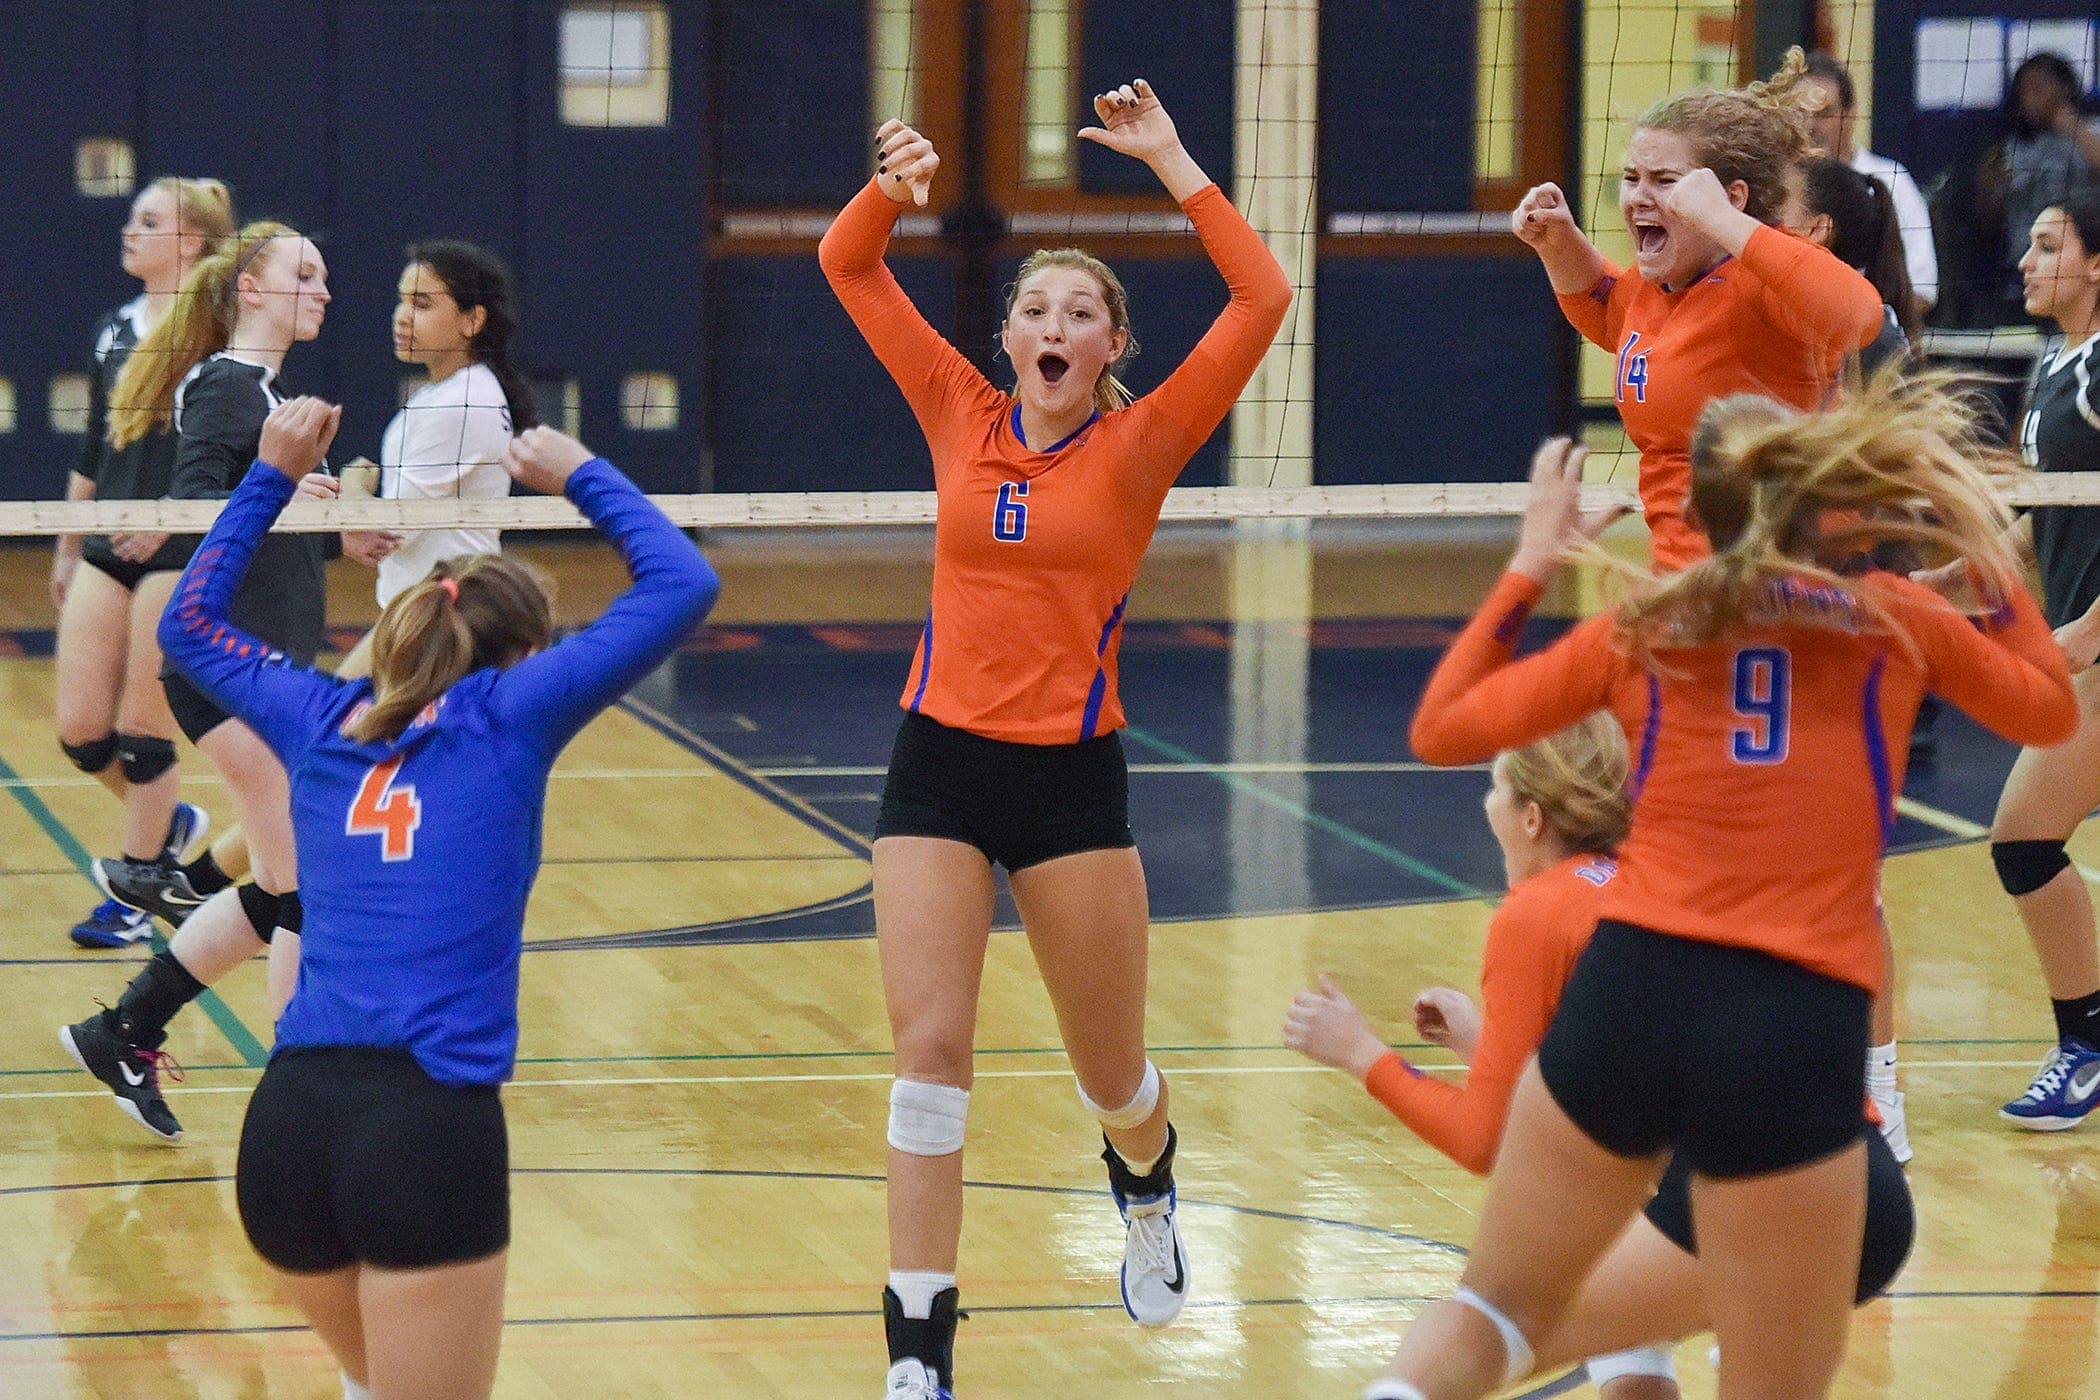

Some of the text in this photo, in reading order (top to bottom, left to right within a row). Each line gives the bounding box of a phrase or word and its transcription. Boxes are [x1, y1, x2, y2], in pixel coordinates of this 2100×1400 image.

[1616, 331, 1652, 402] 14
[992, 480, 1031, 542] 6
[1732, 647, 1792, 764] 9
[345, 752, 422, 863] 4
